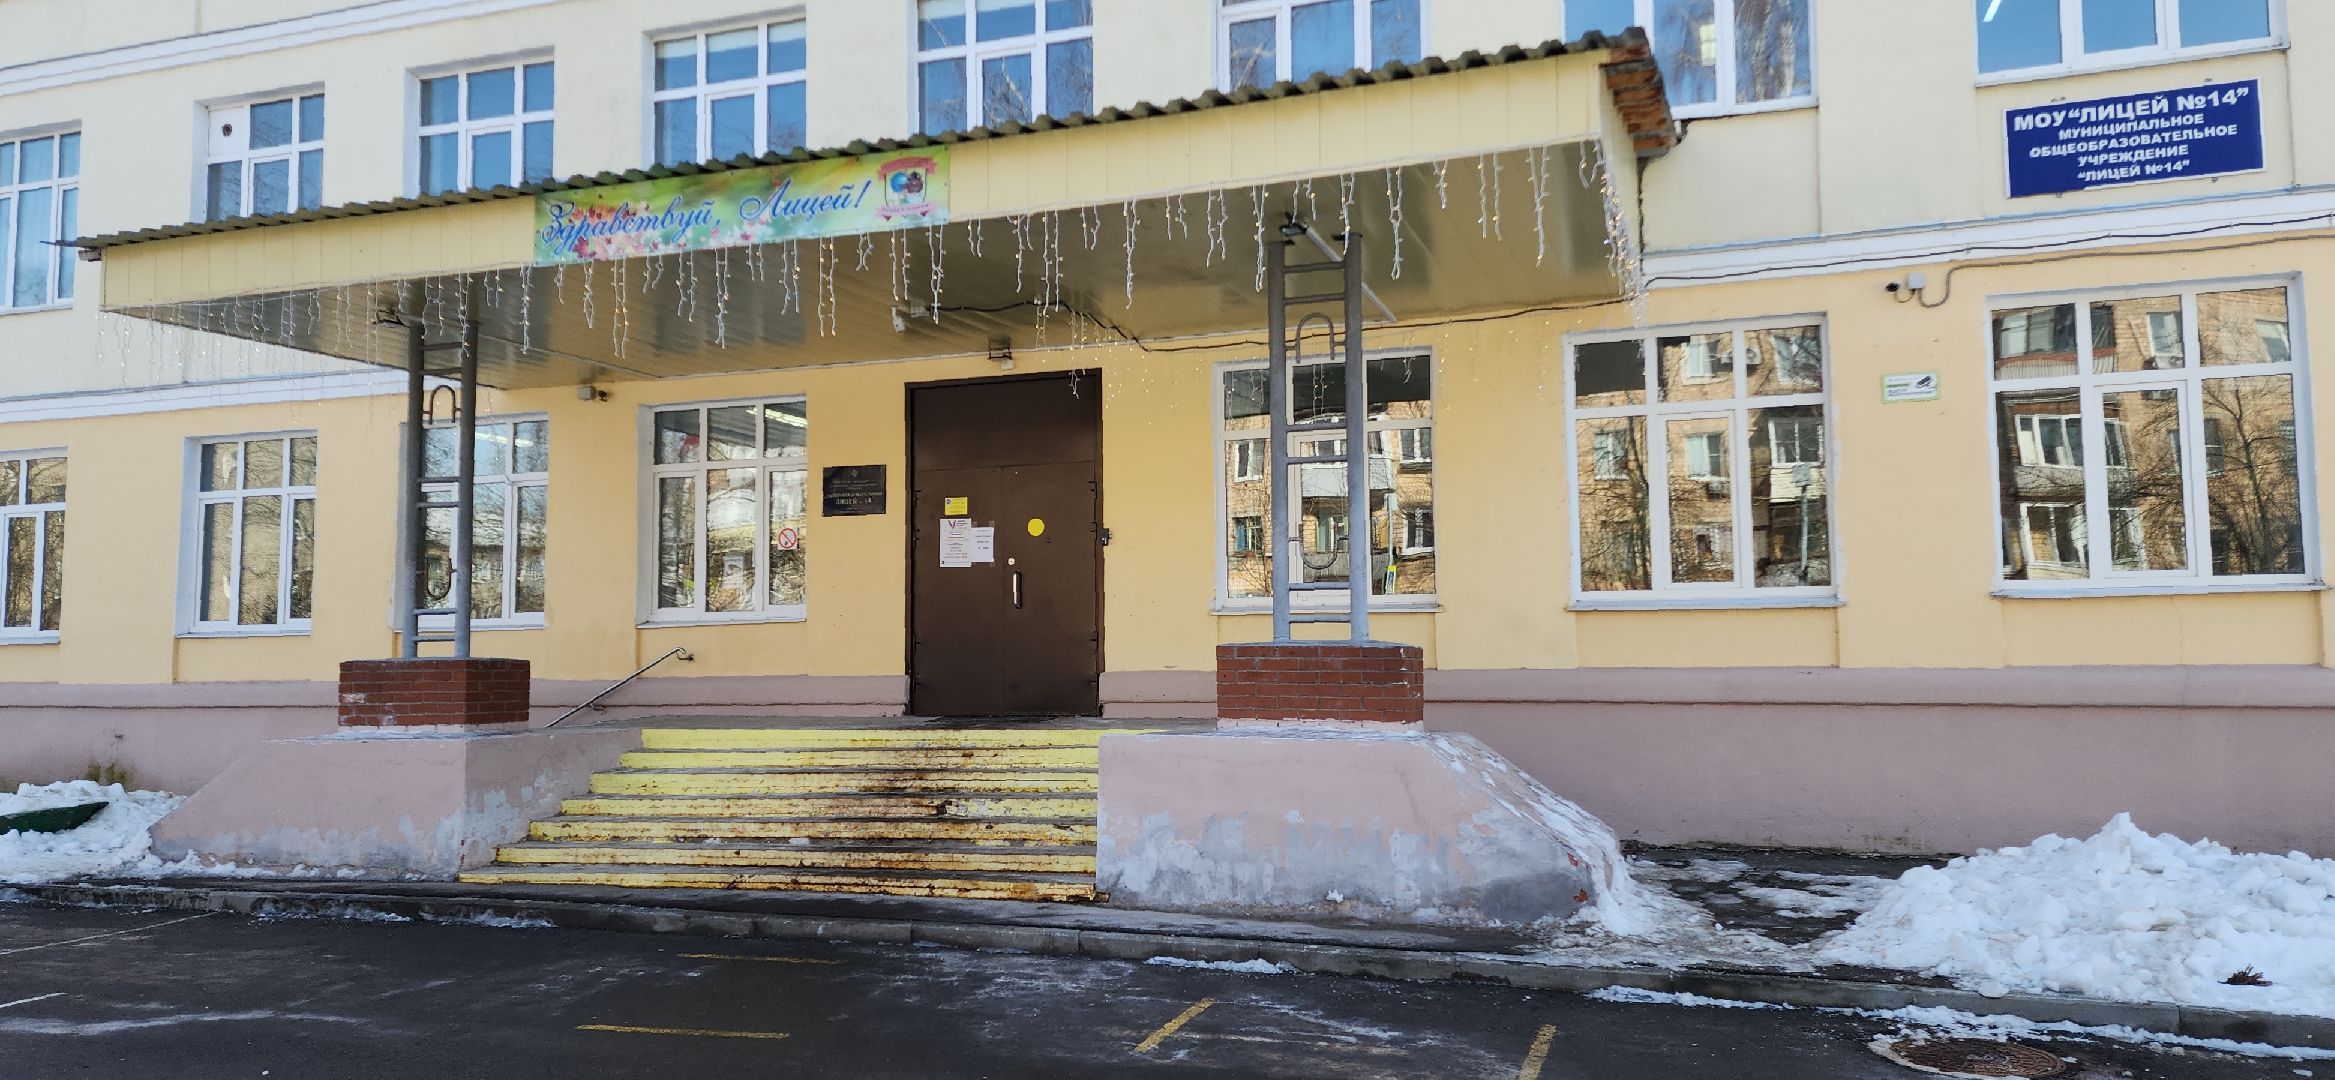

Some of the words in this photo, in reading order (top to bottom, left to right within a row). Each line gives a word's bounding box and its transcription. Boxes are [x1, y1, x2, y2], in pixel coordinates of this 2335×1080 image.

[2029, 124, 2238, 158] ОБЩЕОБРАЗОВАТЕЛЬНОЕ
[2058, 113, 2205, 141] МУНИЦИПАЛЬНОЕ
[2077, 145, 2189, 167] УЧРЕЖДЕНИЕ
[541, 195, 721, 255] Здравствуй,
[741, 177, 873, 222] Лицей!
